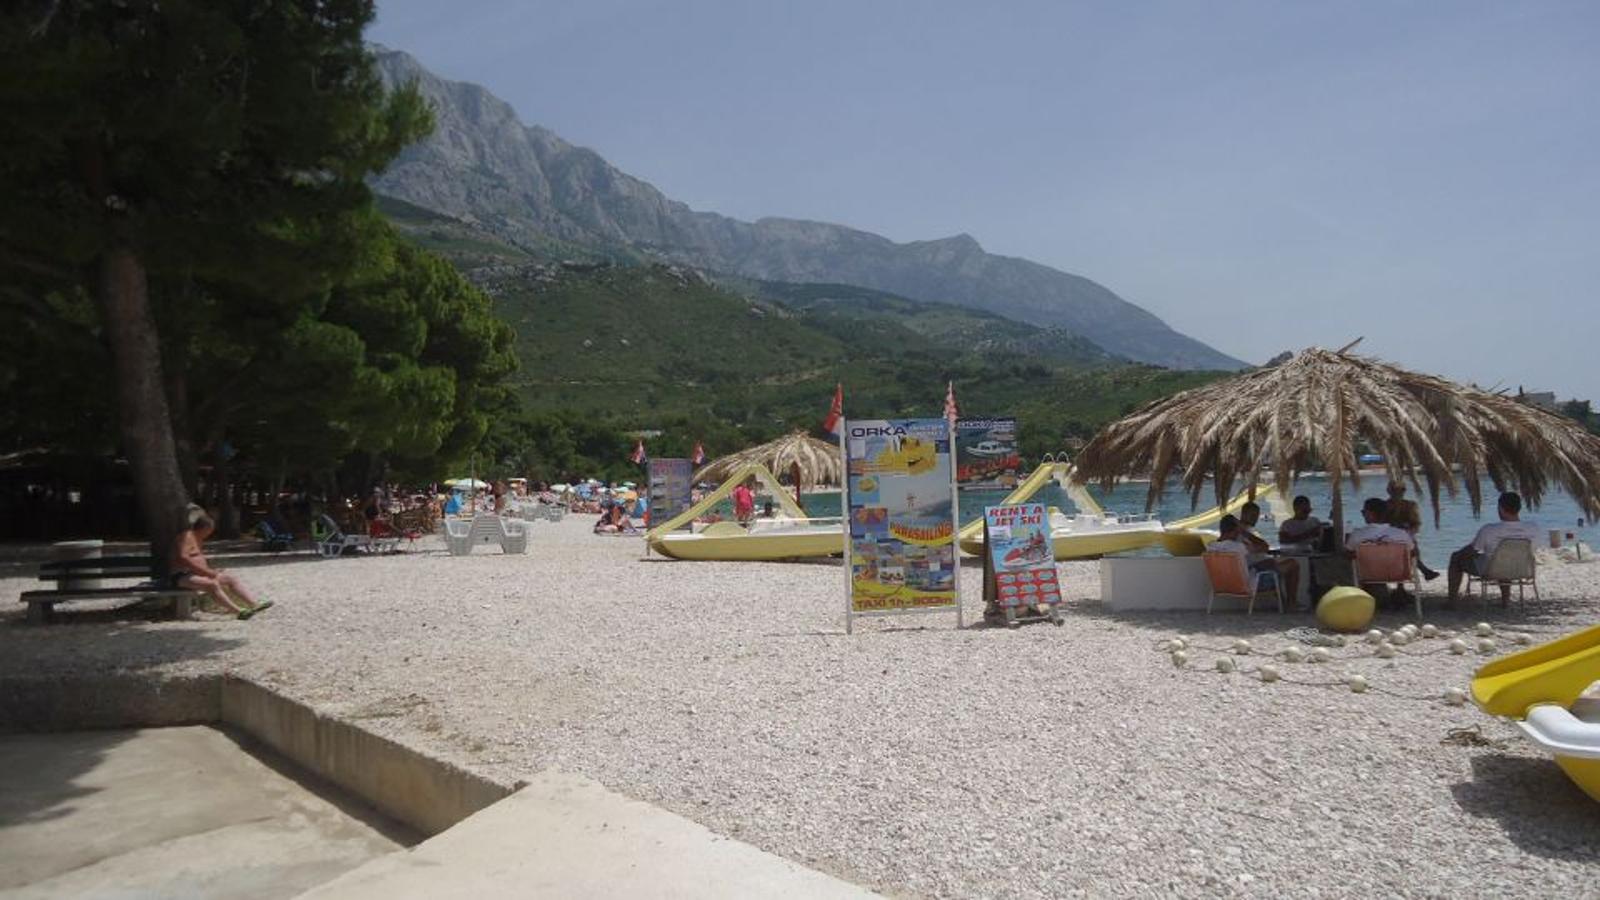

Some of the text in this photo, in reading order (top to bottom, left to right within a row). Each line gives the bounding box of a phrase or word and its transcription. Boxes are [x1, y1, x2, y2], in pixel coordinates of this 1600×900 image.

[851, 425, 907, 438] ORKA
[989, 505, 1043, 517] RENT A
[995, 514, 1041, 526] JET SKI
[855, 599, 886, 609] TAXI
